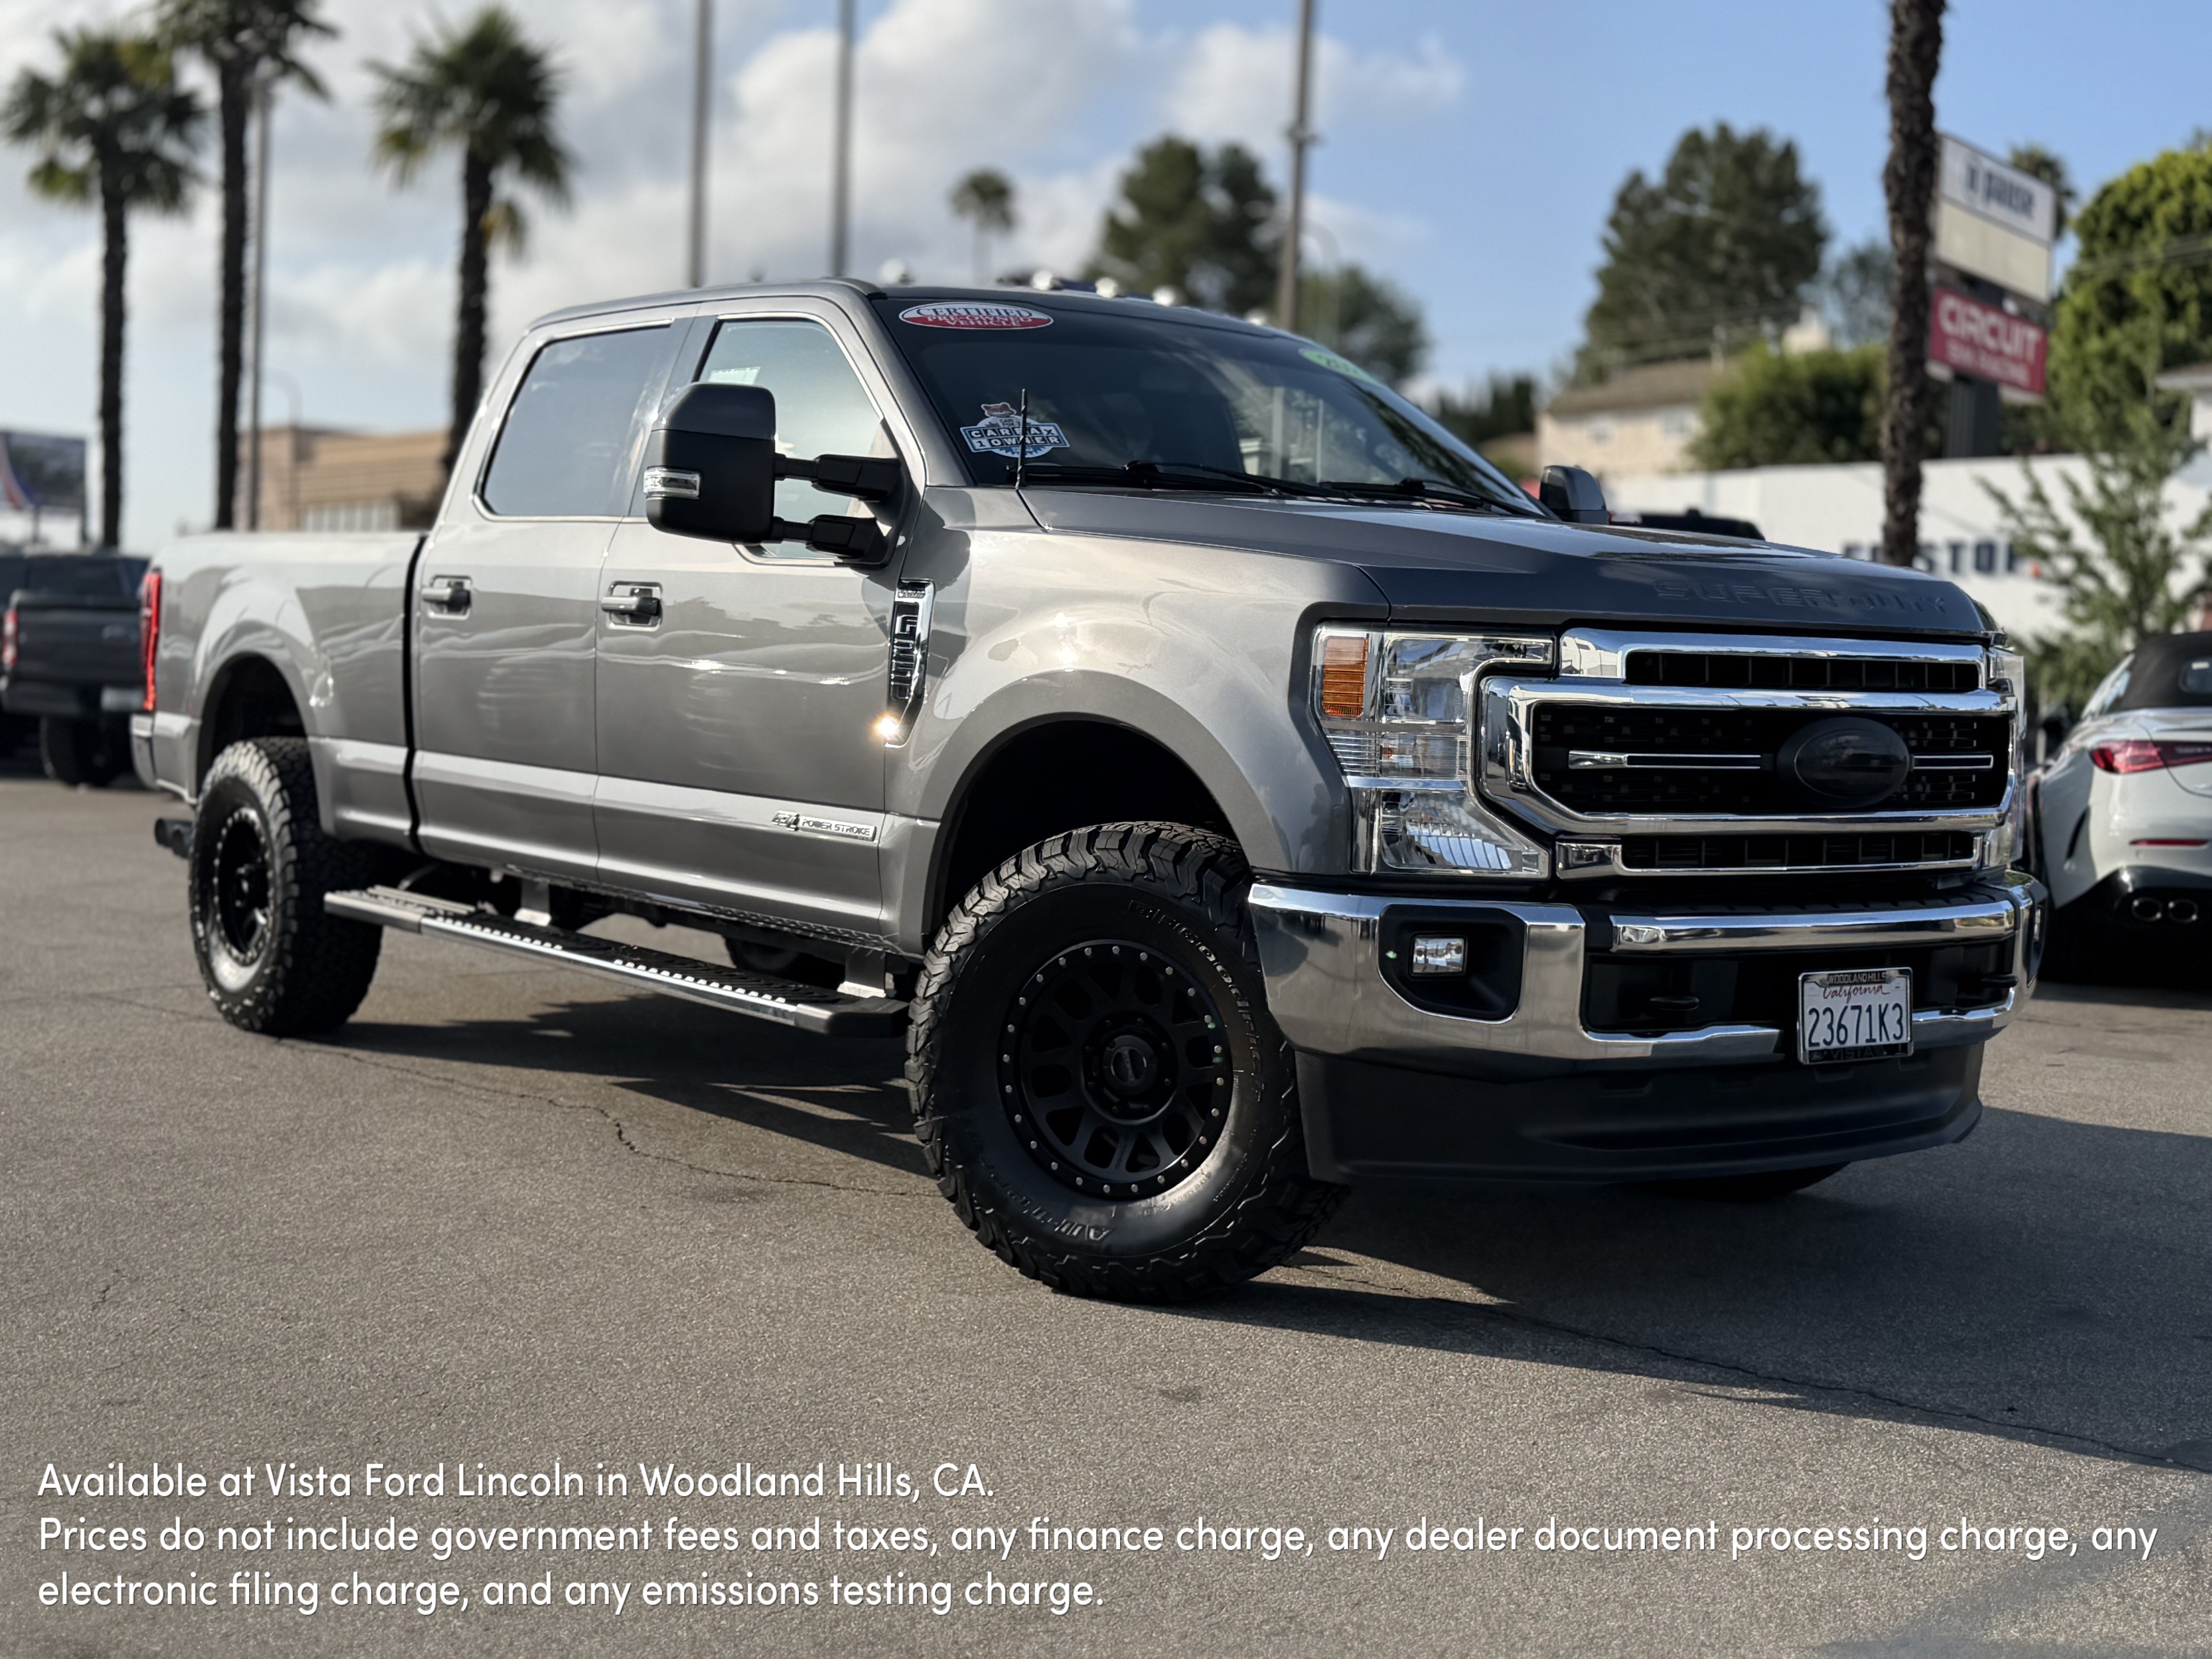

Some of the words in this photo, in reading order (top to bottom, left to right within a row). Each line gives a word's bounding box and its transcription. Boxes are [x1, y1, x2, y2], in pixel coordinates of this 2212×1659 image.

[917, 308, 1032, 318] CERTIFIED
[970, 426, 1055, 438] CARFAX
[1653, 579, 1836, 608] SUPER
[802, 819, 832, 830] POWER
[834, 824, 871, 836] STROKE
[1828, 973, 1868, 984] WOODLAND
[1823, 984, 1891, 1004] California
[1808, 1003, 1904, 1047] 23671K3
